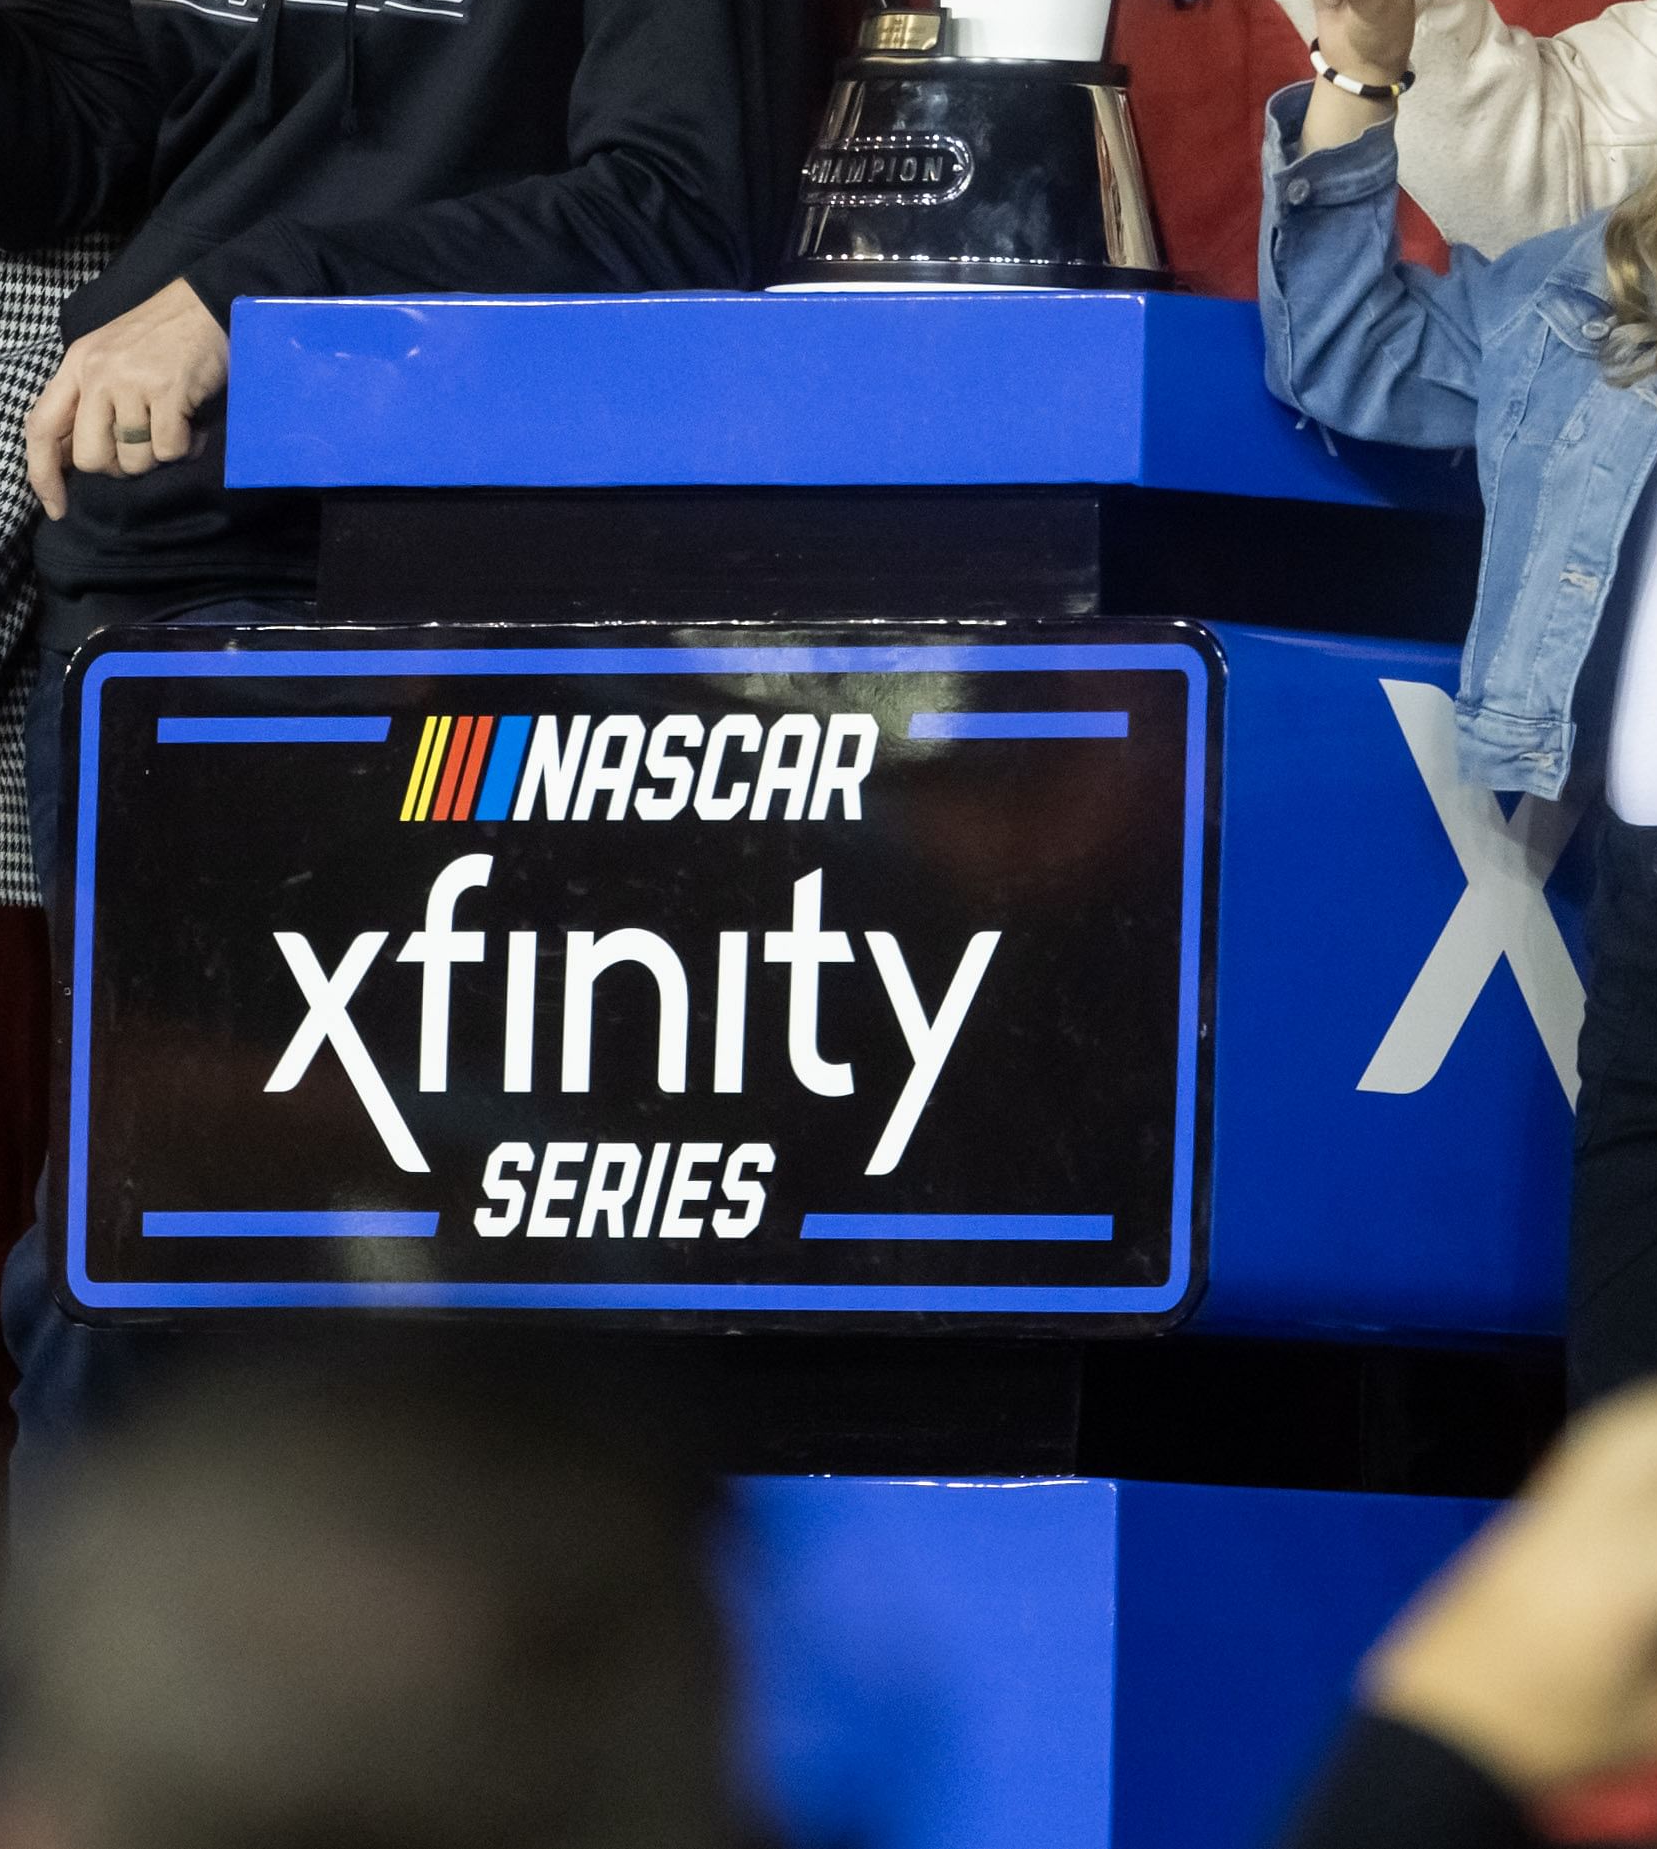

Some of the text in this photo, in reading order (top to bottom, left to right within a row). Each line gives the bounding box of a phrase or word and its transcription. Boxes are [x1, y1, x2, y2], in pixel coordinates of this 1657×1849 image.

[512, 713, 880, 821] NASCAR
[263, 853, 1003, 1177] xfinity
[473, 1142, 777, 1240] SERIES
